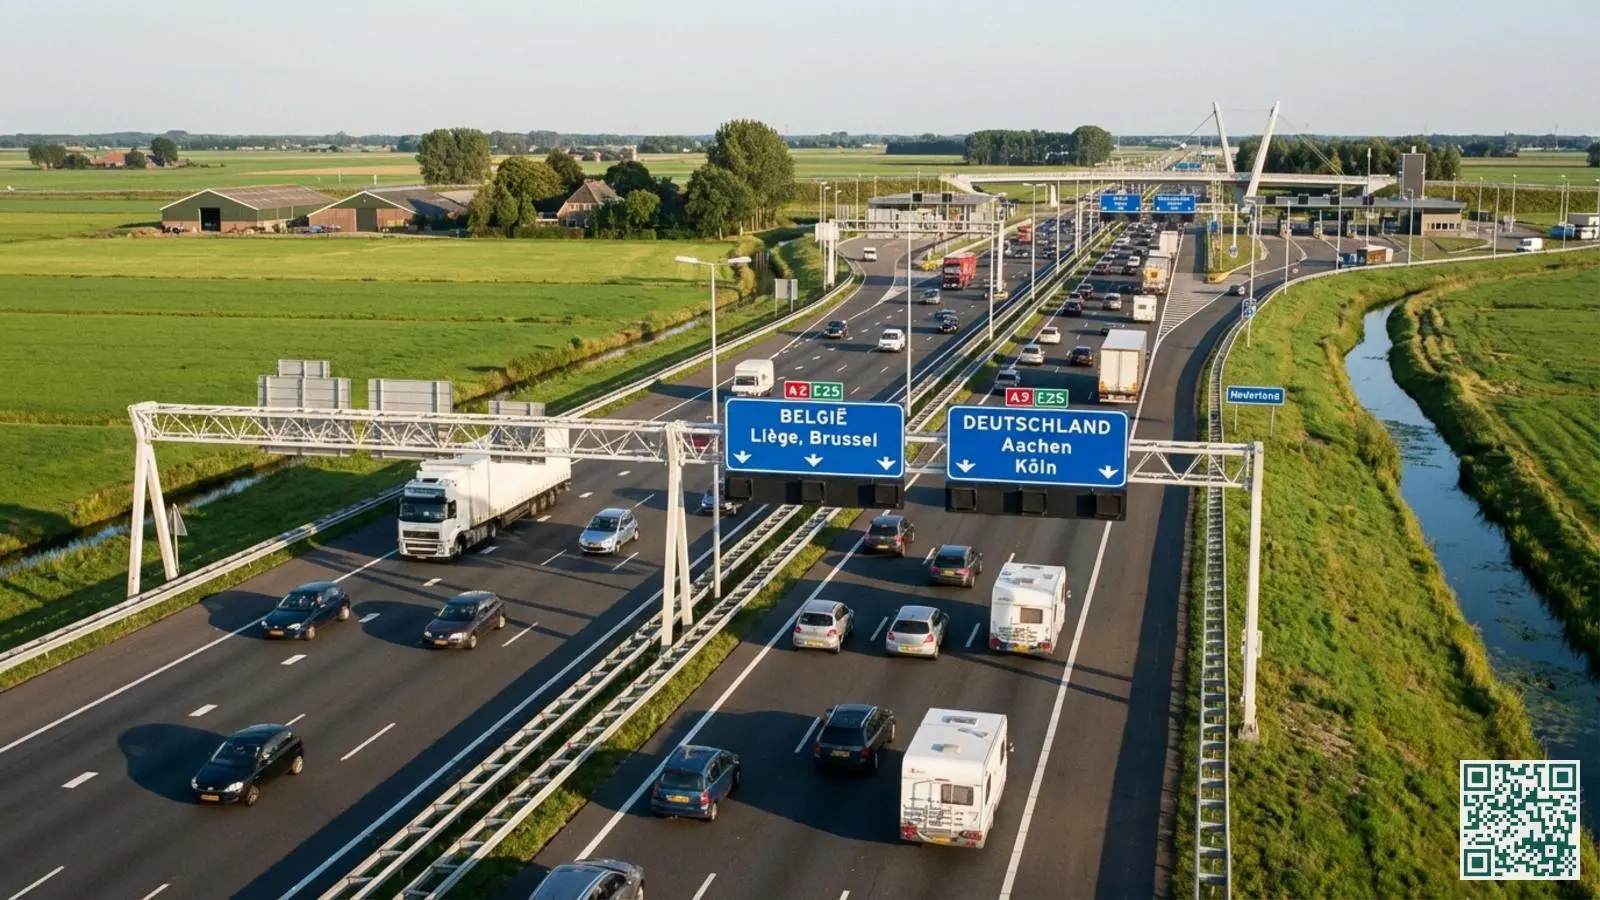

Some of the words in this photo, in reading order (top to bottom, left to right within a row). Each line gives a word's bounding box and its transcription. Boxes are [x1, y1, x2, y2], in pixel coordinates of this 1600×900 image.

[789, 385, 807, 397] A2
[1010, 391, 1030, 403] A9
[780, 407, 848, 426] BELGIË
[963, 414, 1111, 435] DEUTSCHLAND
[750, 427, 803, 448] Liège,
[809, 430, 878, 448] Brussel
[1001, 437, 1072, 455] Aachen
